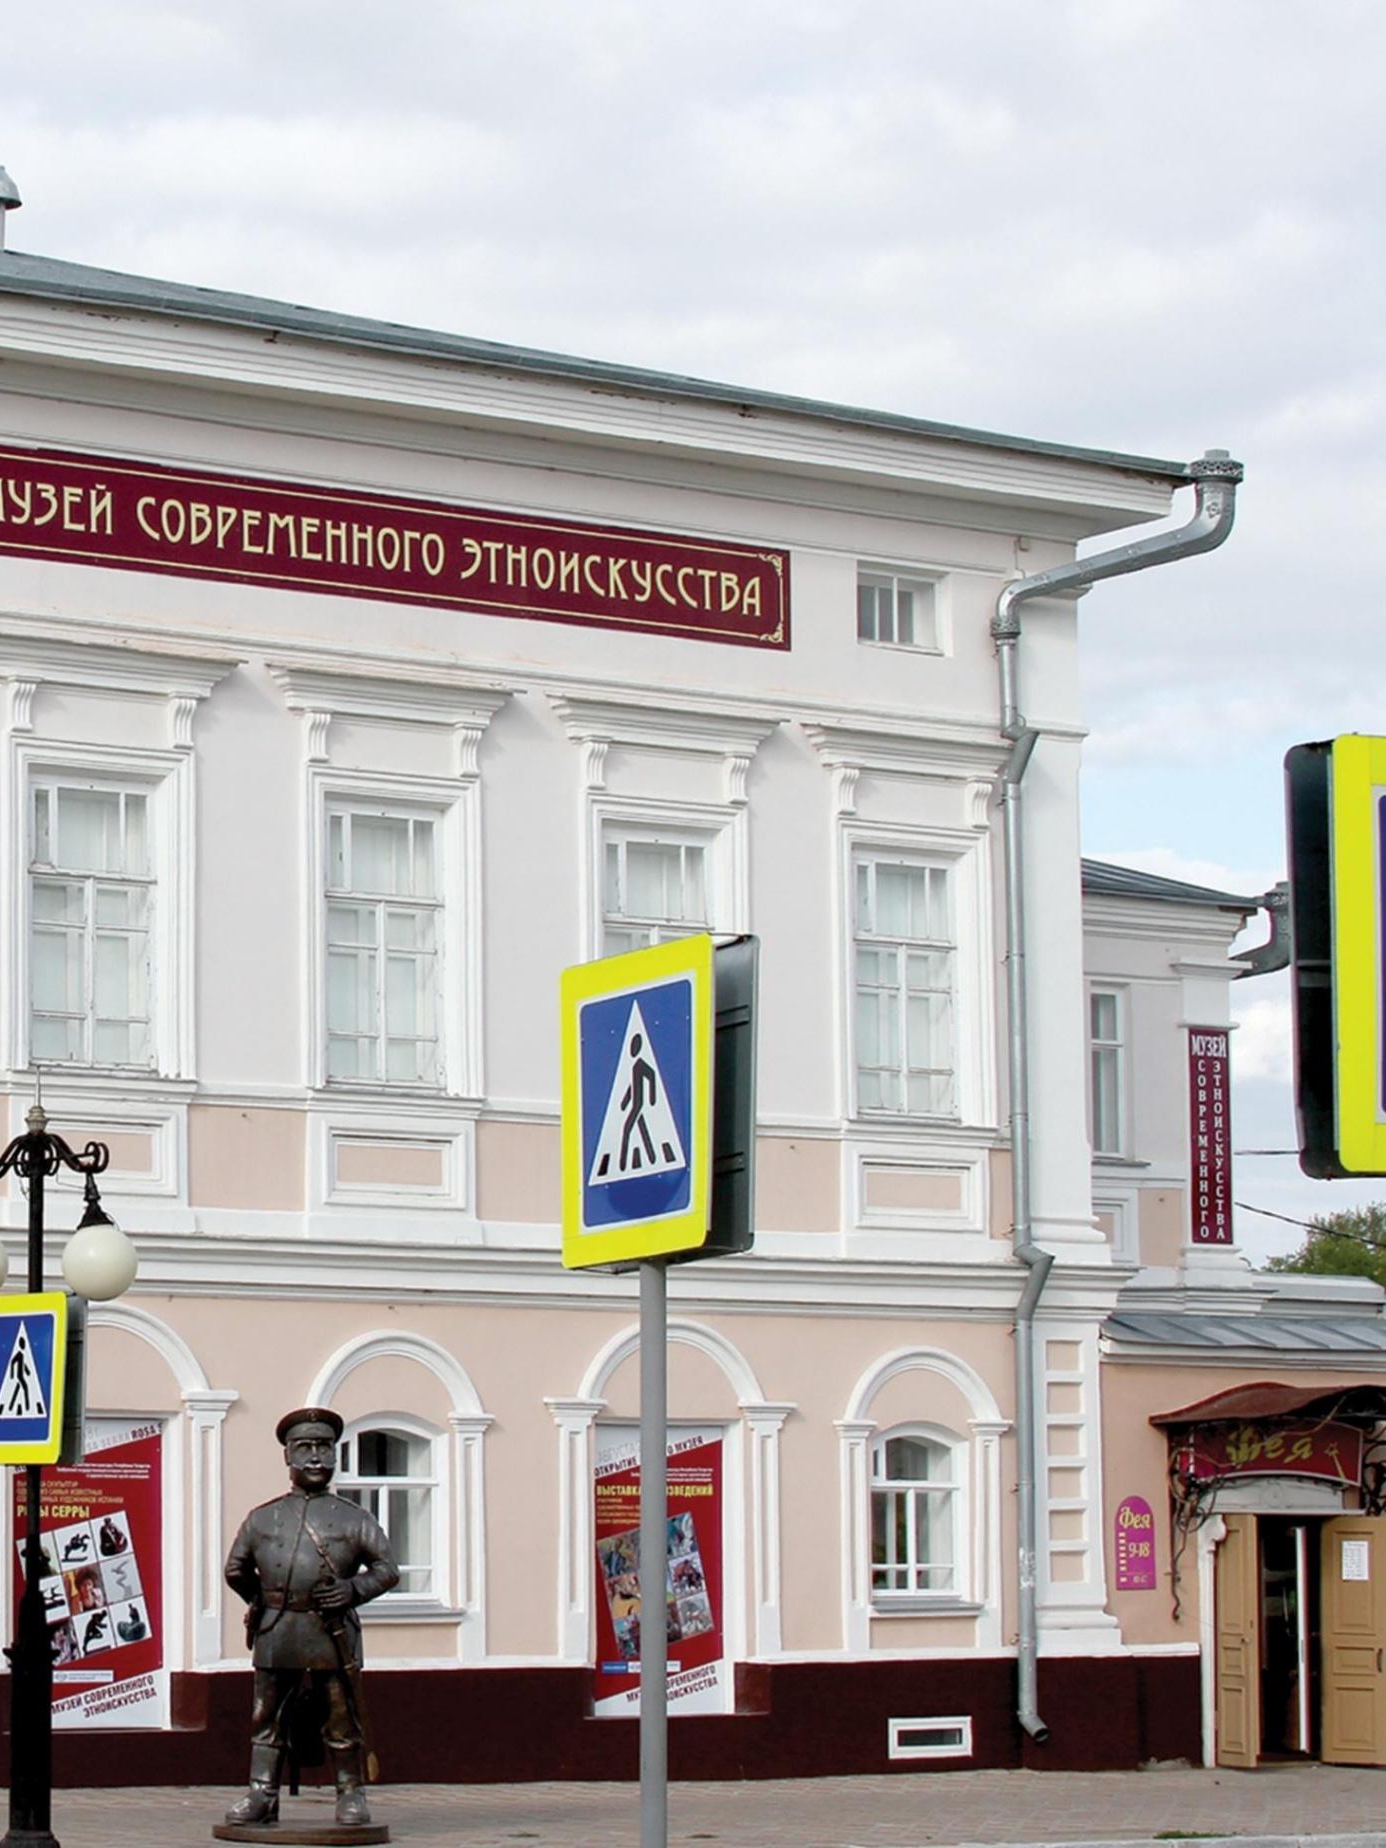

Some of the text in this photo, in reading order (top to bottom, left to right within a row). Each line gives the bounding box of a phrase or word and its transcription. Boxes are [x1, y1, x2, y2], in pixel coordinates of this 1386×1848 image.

[135, 495, 445, 577] СОВРЕМЕННОГО
[460, 537, 762, 617] ЭТНОИСКУССТВА
[1191, 1034, 1228, 1059] МУЗЕЙ
[1197, 1059, 1210, 1239] СОВРЕМЕННОГО
[1212, 1060, 1226, 1240] ЭТНОИСКУССТВА
[131, 1424, 157, 1439] ROSA
[594, 1456, 637, 1478] ОТКРЫТИЕ
[51, 1505, 90, 1518] СЕРРЫ
[1119, 1506, 1151, 1529] Фея
[83, 1674, 155, 1704] СОВРЕМЕННОГО
[83, 1687, 158, 1718] ЭТНОИСКУССТВА
